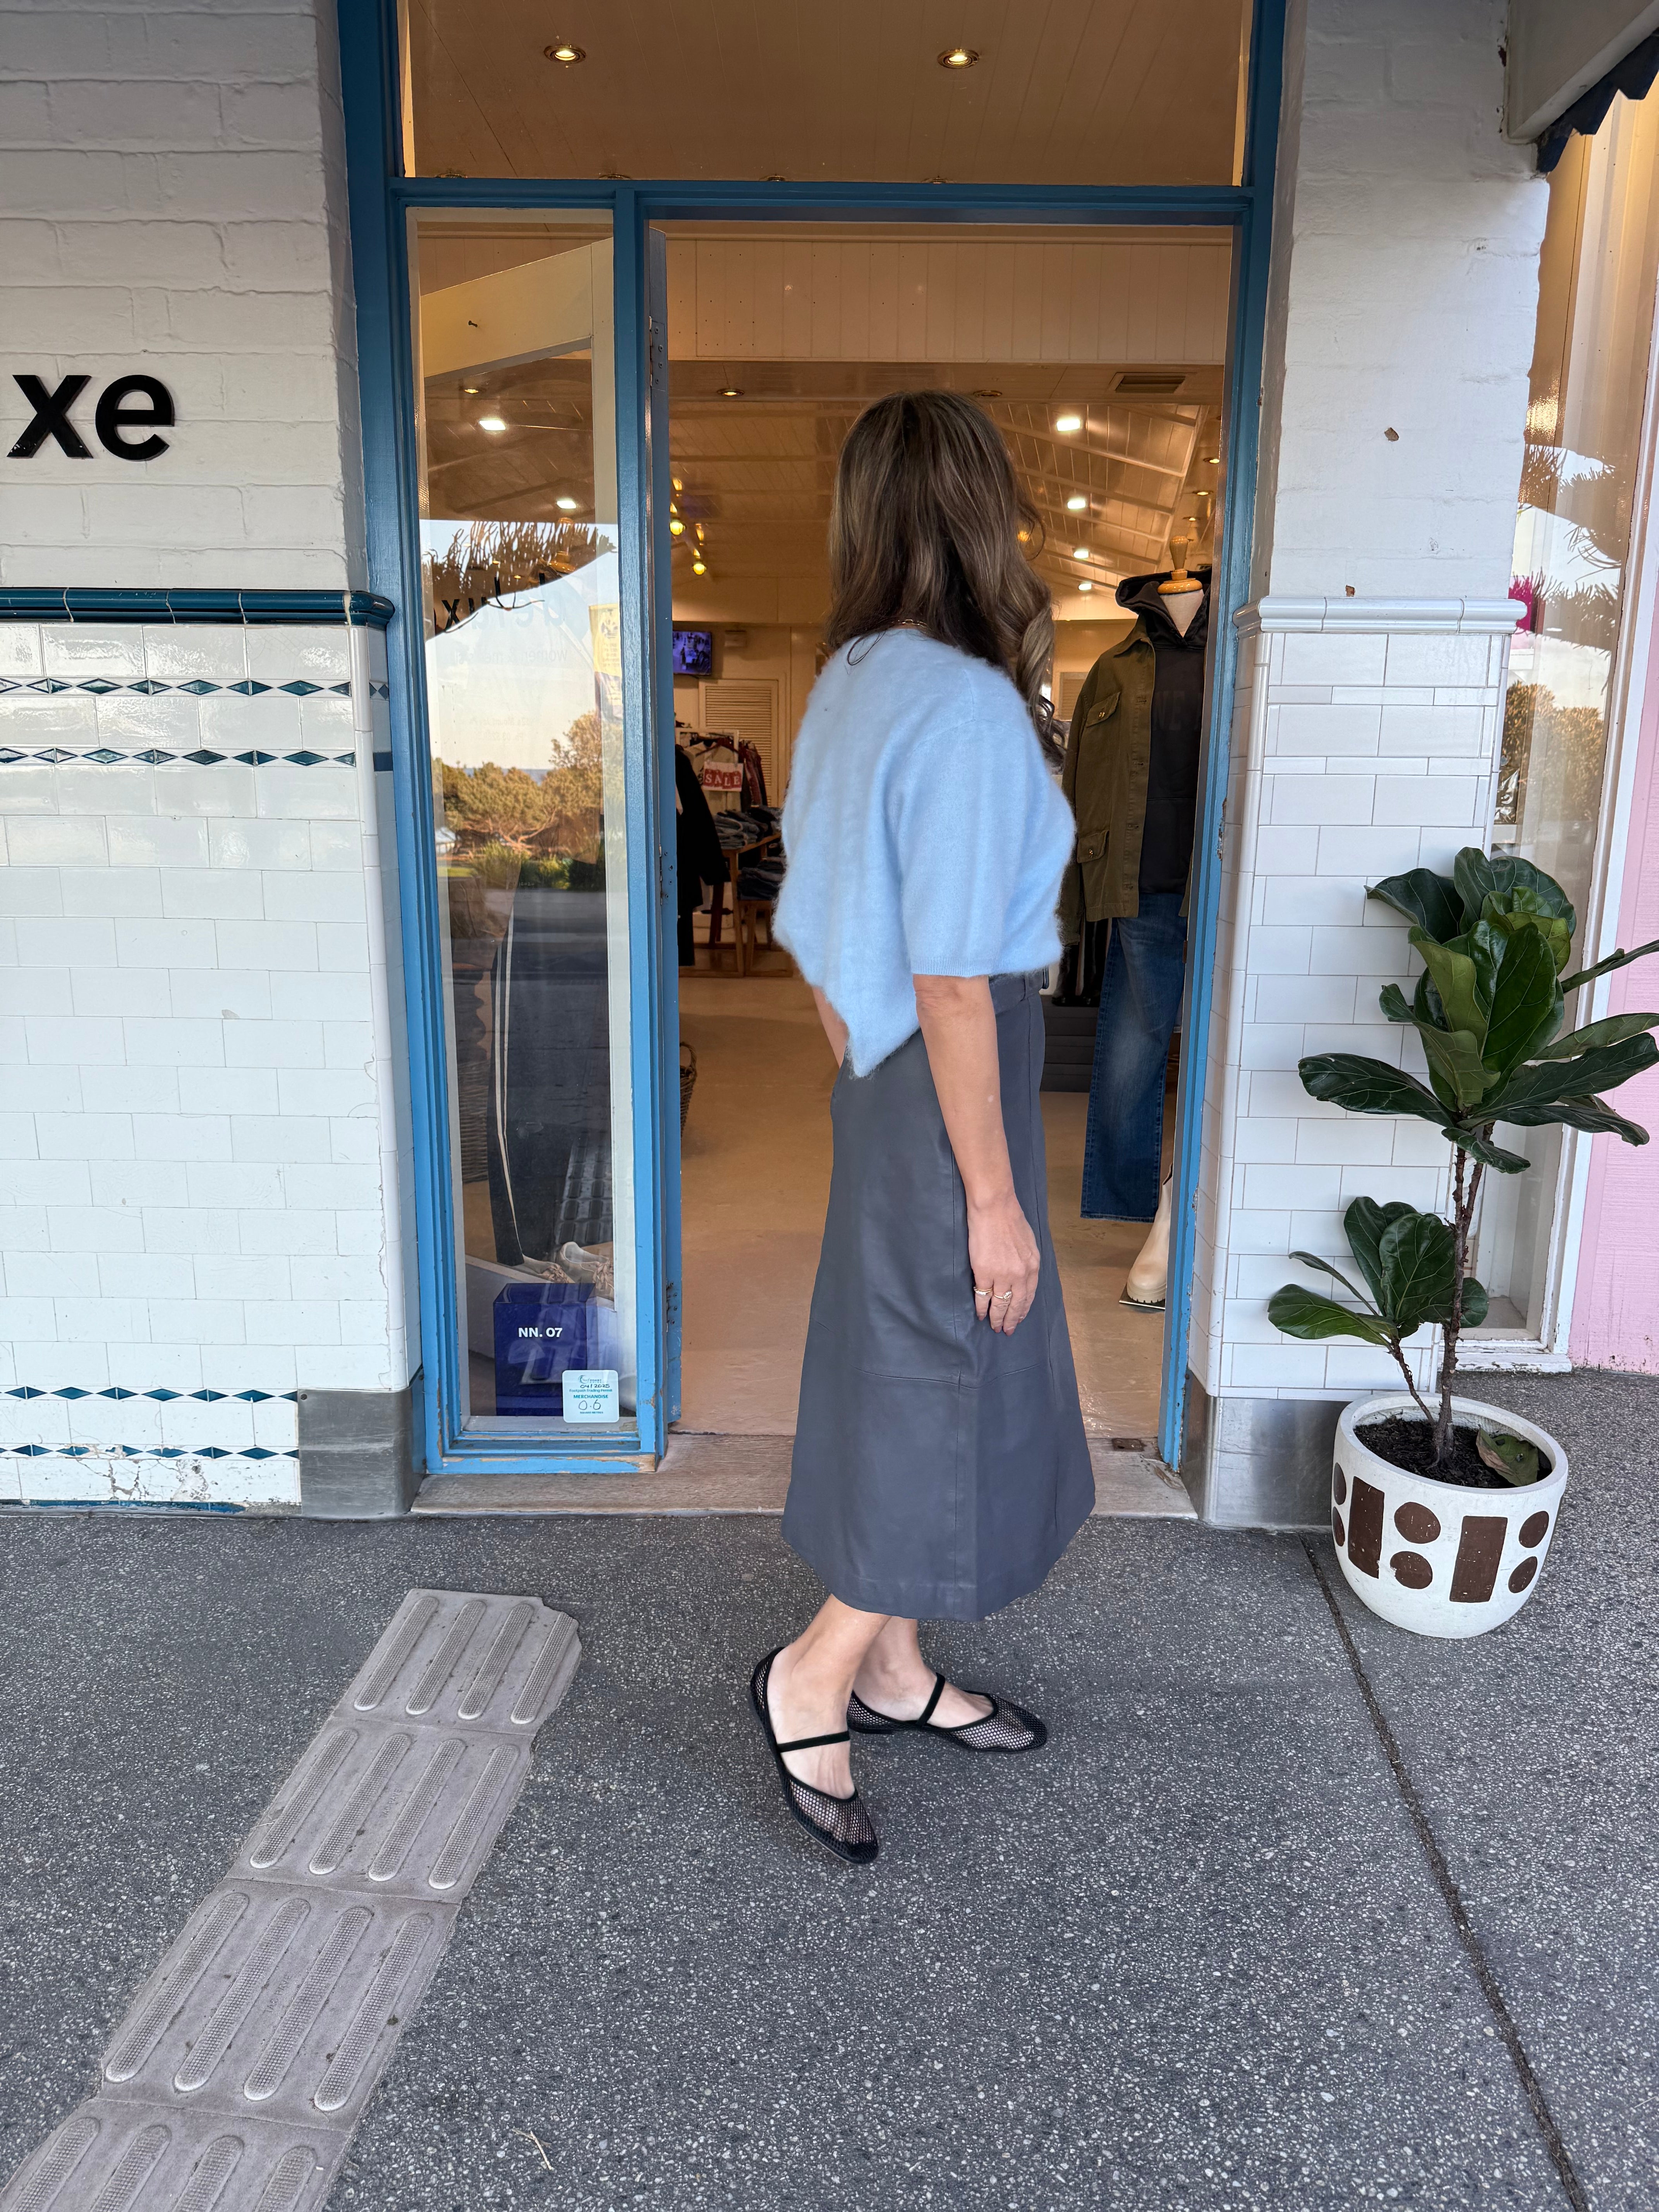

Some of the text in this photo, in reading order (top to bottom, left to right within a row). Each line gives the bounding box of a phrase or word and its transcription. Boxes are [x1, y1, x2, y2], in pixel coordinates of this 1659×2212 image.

[7, 374, 175, 462] xe
[705, 774, 740, 786] SALE
[518, 1328, 563, 1337] NN. 07
[579, 1399, 601, 1410] 0.6
